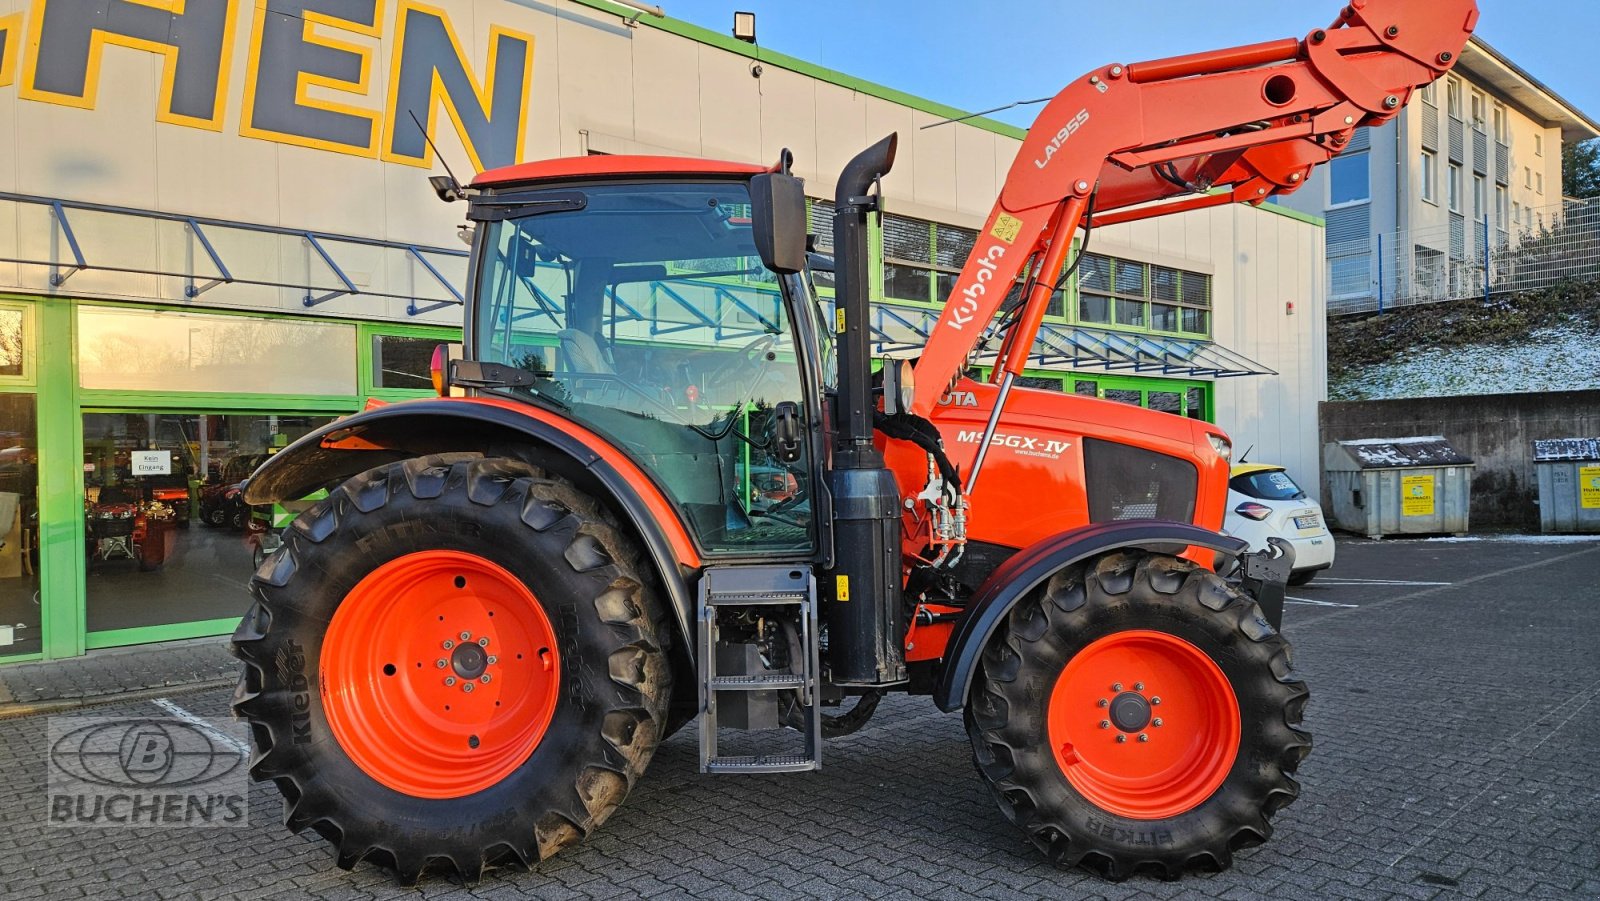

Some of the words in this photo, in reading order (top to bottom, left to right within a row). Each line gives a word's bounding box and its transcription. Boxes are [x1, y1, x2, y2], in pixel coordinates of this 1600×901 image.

[0, 0, 535, 174] HEN
[1034, 108, 1090, 170] LA1955
[947, 245, 1006, 331] Kubota
